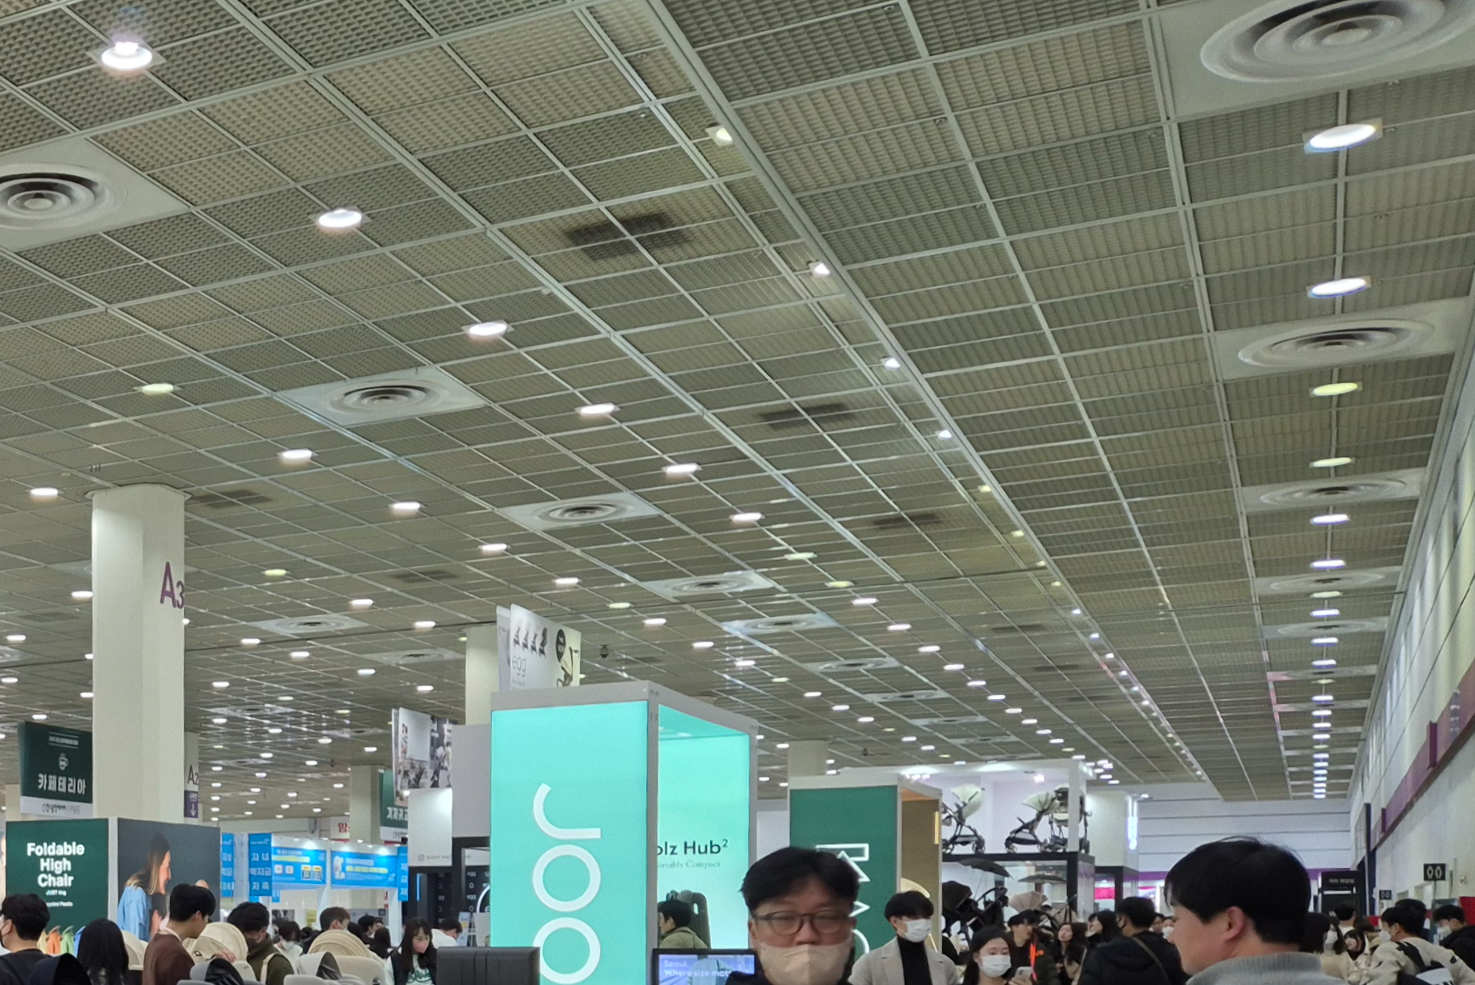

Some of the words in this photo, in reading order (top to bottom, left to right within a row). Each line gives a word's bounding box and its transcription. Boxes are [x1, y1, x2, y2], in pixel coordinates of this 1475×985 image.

[159, 560, 185, 610] A3
[38, 774, 86, 795] 카페테리아
[26, 842, 86, 857] Foldable
[39, 858, 72, 875] High
[686, 860, 721, 869] Compact
[37, 873, 75, 888] Chair
[664, 969, 692, 977] Where
[694, 969, 711, 977] size
